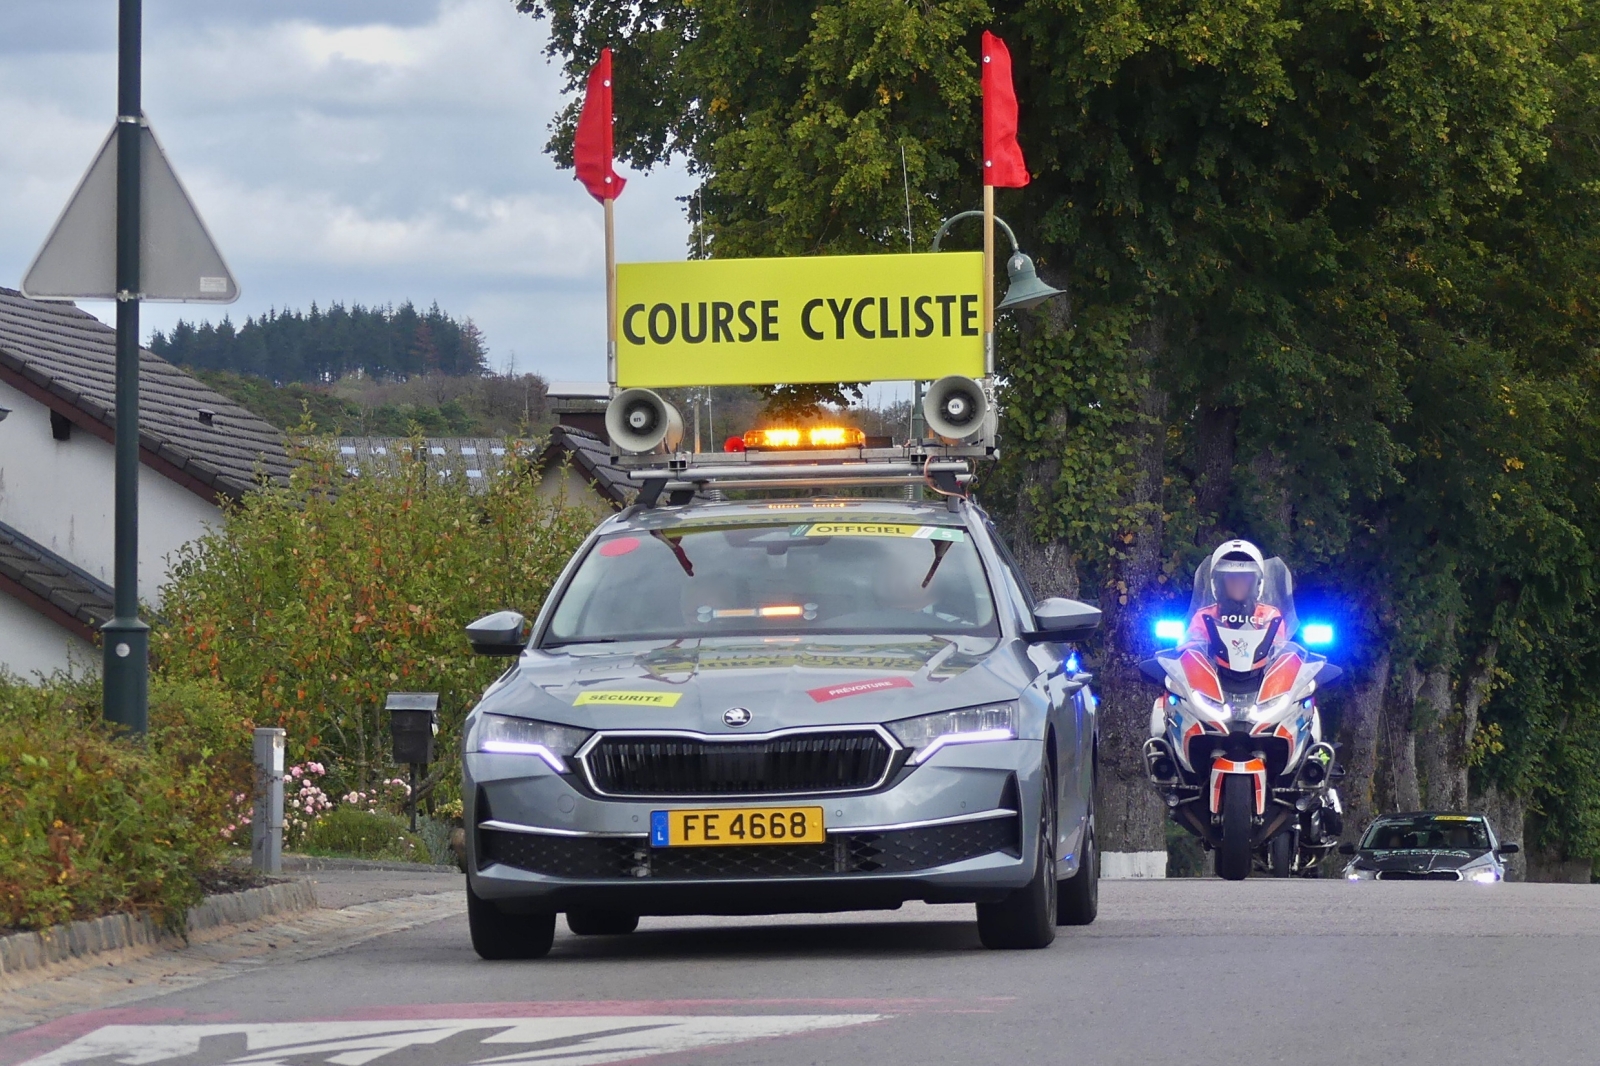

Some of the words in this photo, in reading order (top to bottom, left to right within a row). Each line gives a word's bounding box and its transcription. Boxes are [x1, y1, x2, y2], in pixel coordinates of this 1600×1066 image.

[622, 299, 779, 346] COURSE
[801, 294, 980, 342] CYCLISTE
[816, 525, 906, 535] OFFICIEL
[1221, 614, 1265, 625] POLICE
[828, 680, 894, 696] PRÉVOITURE
[588, 693, 664, 703] SÉCURITÉ
[683, 814, 720, 841] FE
[729, 812, 807, 840] 4668
[656, 831, 664, 841] L
